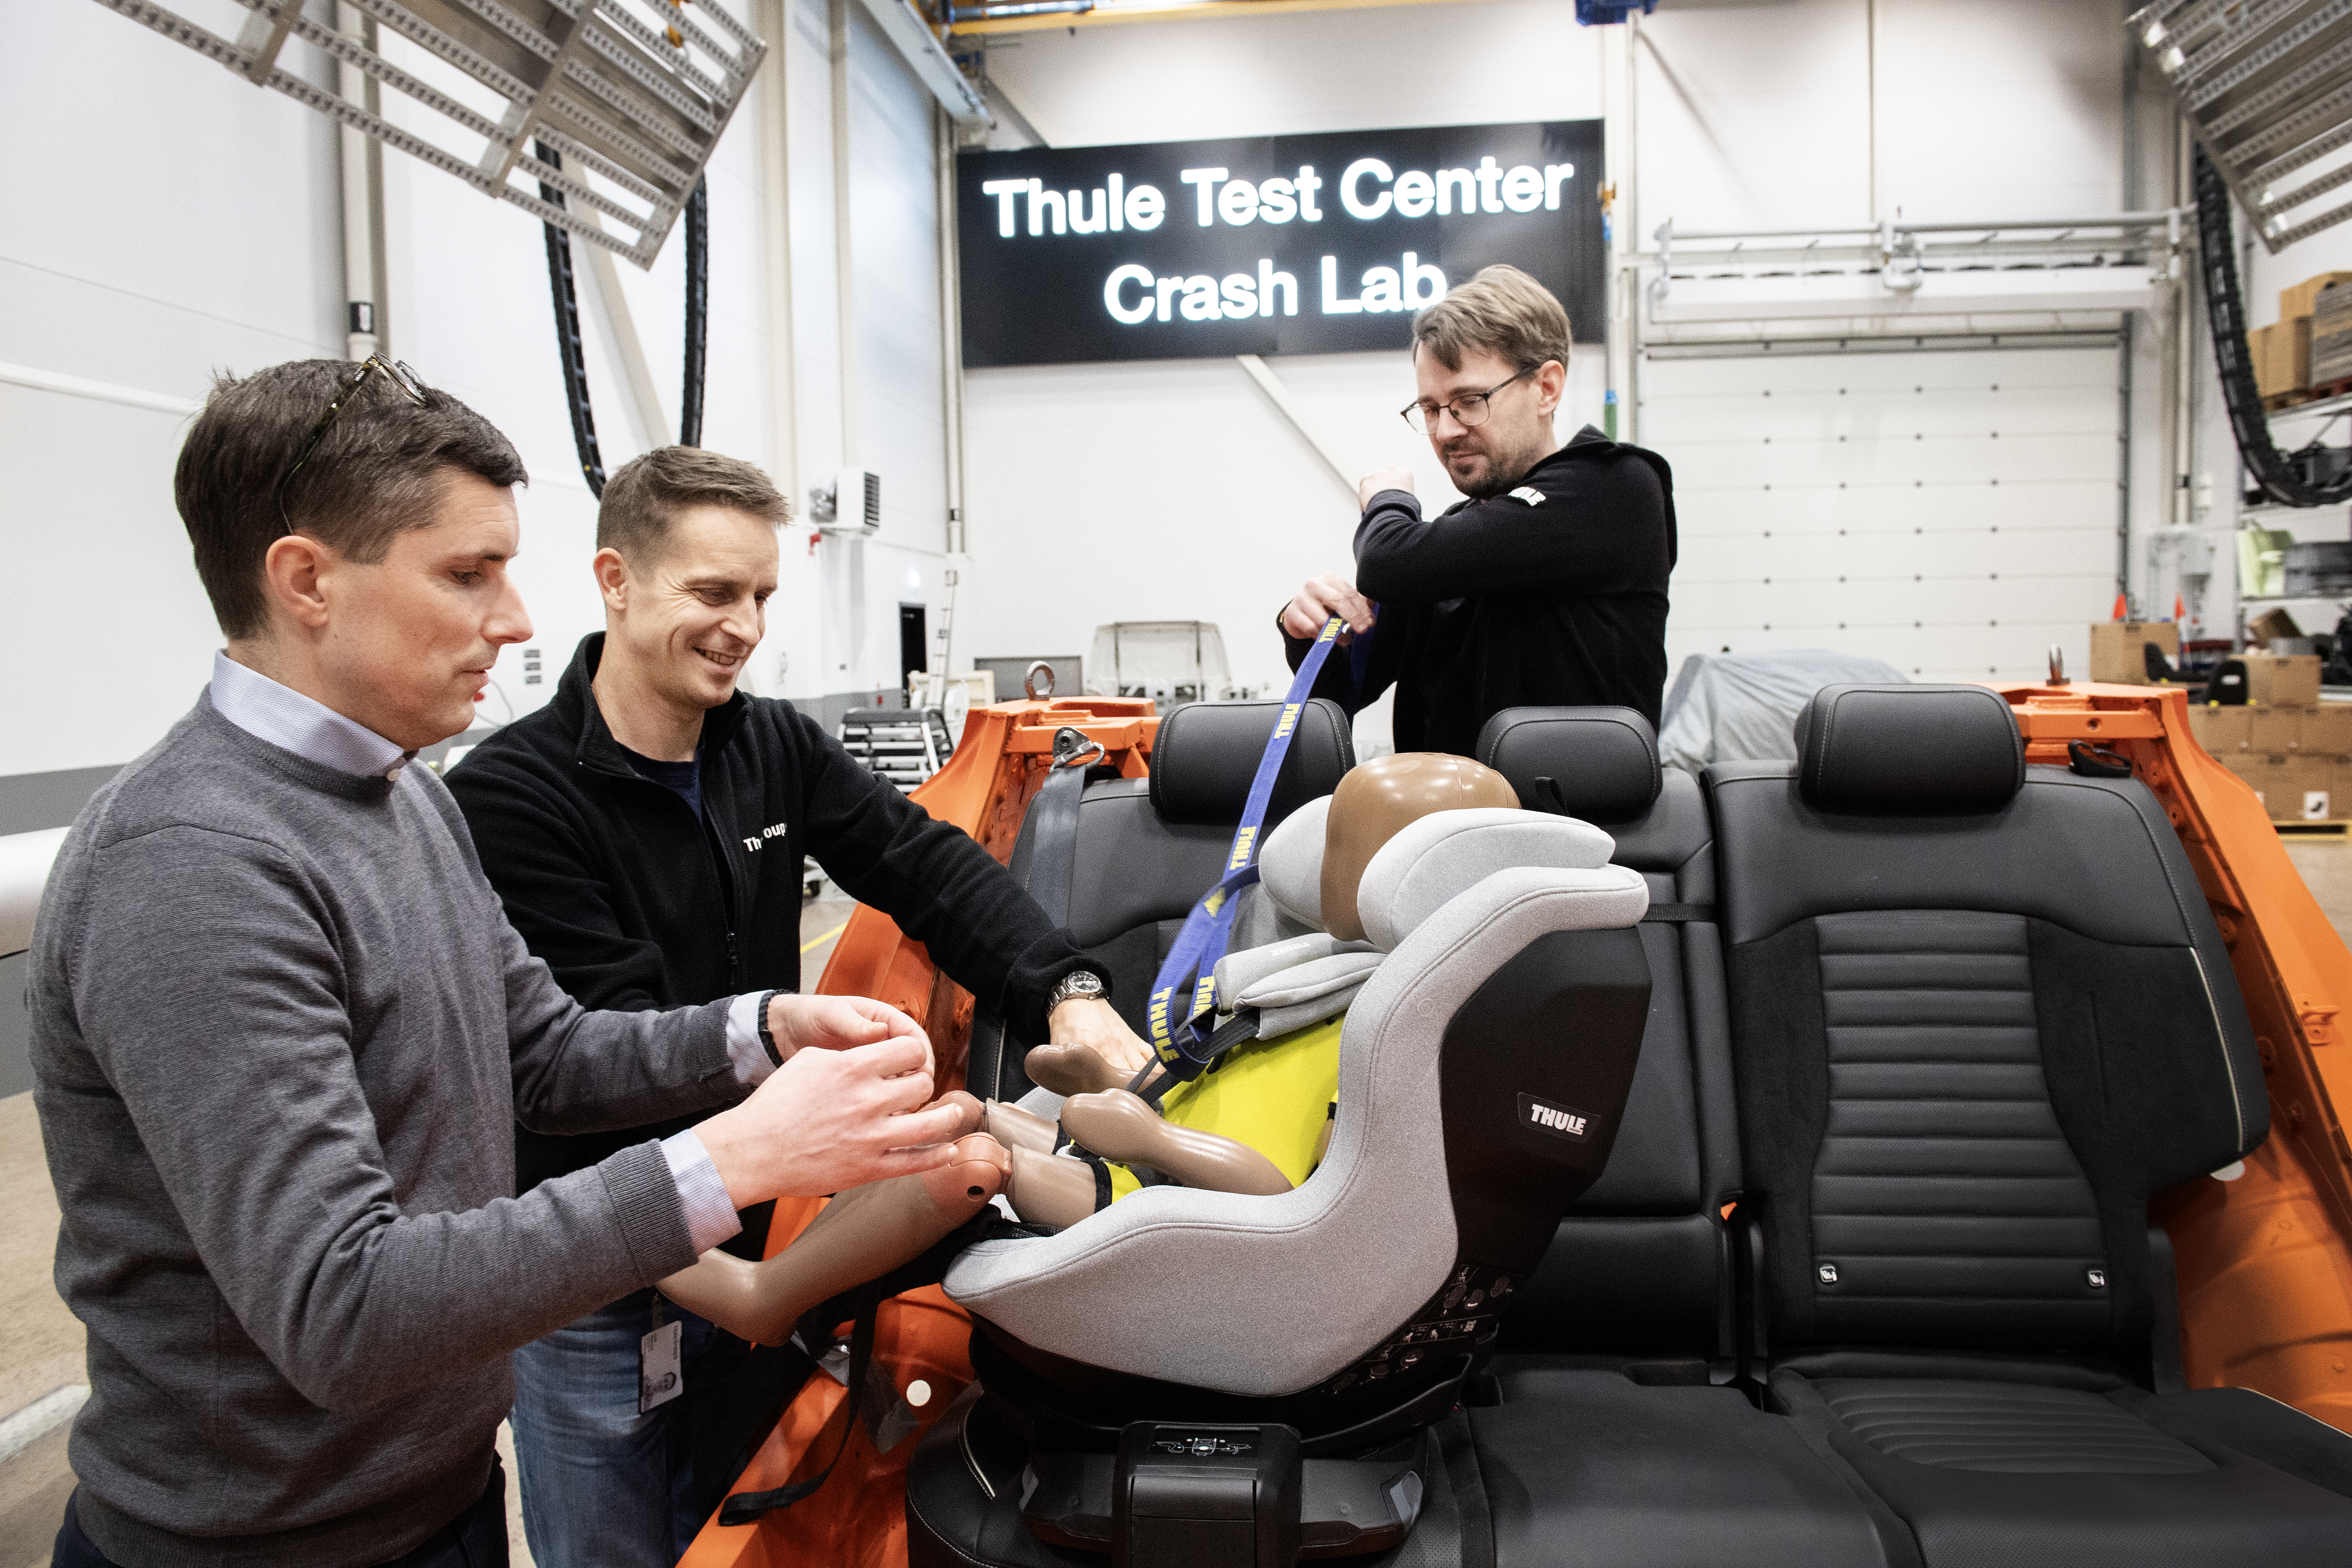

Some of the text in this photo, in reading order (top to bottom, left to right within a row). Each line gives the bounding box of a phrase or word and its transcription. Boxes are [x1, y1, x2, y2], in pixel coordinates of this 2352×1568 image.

[983, 156, 1574, 237] Thule Test Center
[1104, 252, 1447, 324] Crash Lab
[1274, 703, 1301, 739] THULE
[1230, 826, 1257, 870] THULE
[1192, 976, 1215, 1016] HULE
[1150, 986, 1180, 1063] THULE
[1531, 1103, 1587, 1135] THULE
